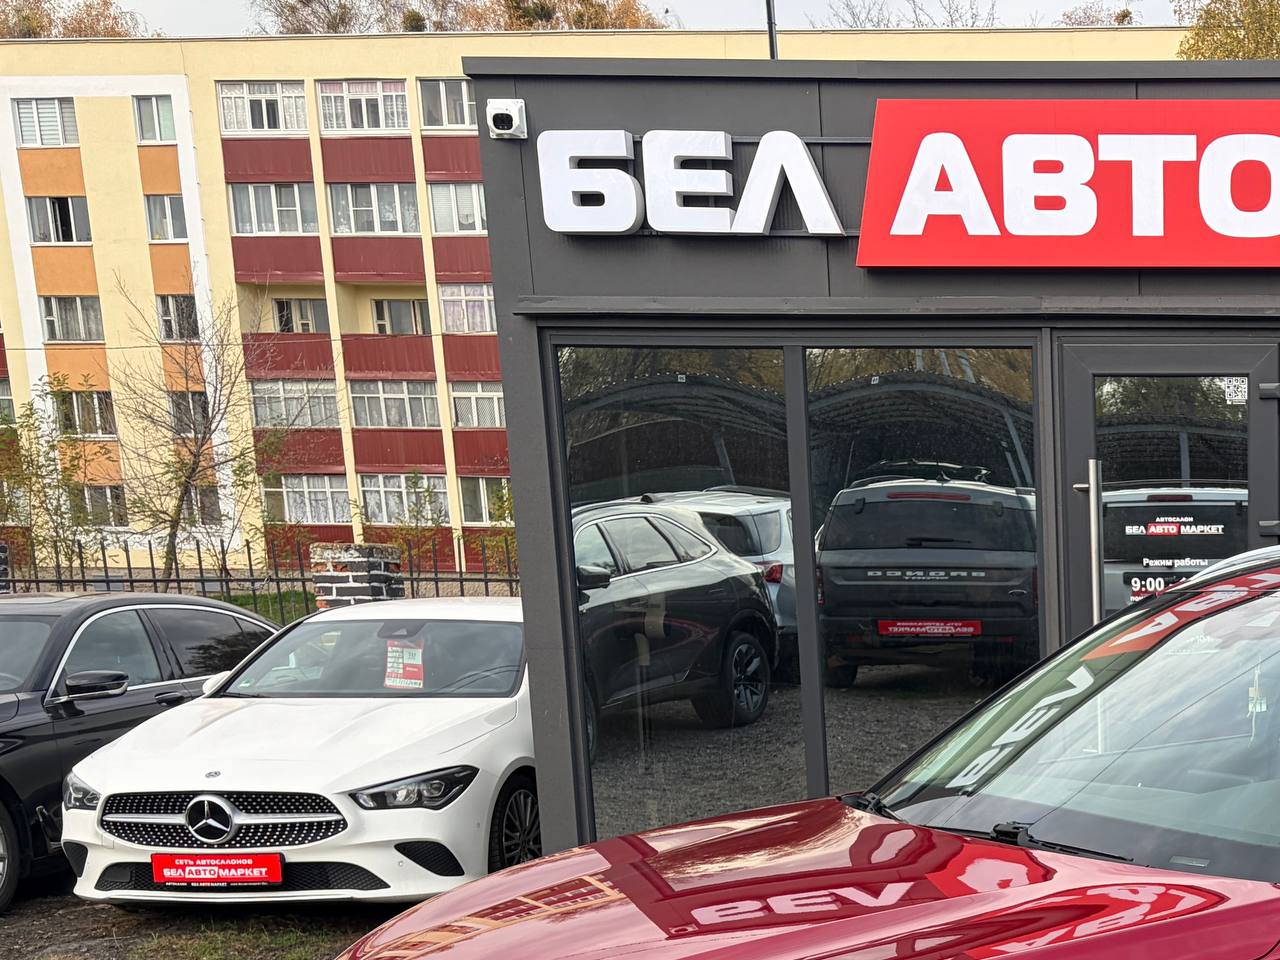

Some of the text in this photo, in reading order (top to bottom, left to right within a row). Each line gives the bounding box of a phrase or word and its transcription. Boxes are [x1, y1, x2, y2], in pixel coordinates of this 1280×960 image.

[536, 129, 847, 237] БЕЛ
[1125, 525, 1225, 535] БЕЛ АВТО МАРКЕТ
[1143, 557, 1208, 568] Режим работы
[1131, 577, 1164, 591] 9:00
[163, 868, 268, 876] БЕЛ АВТО МАРКЕТ
